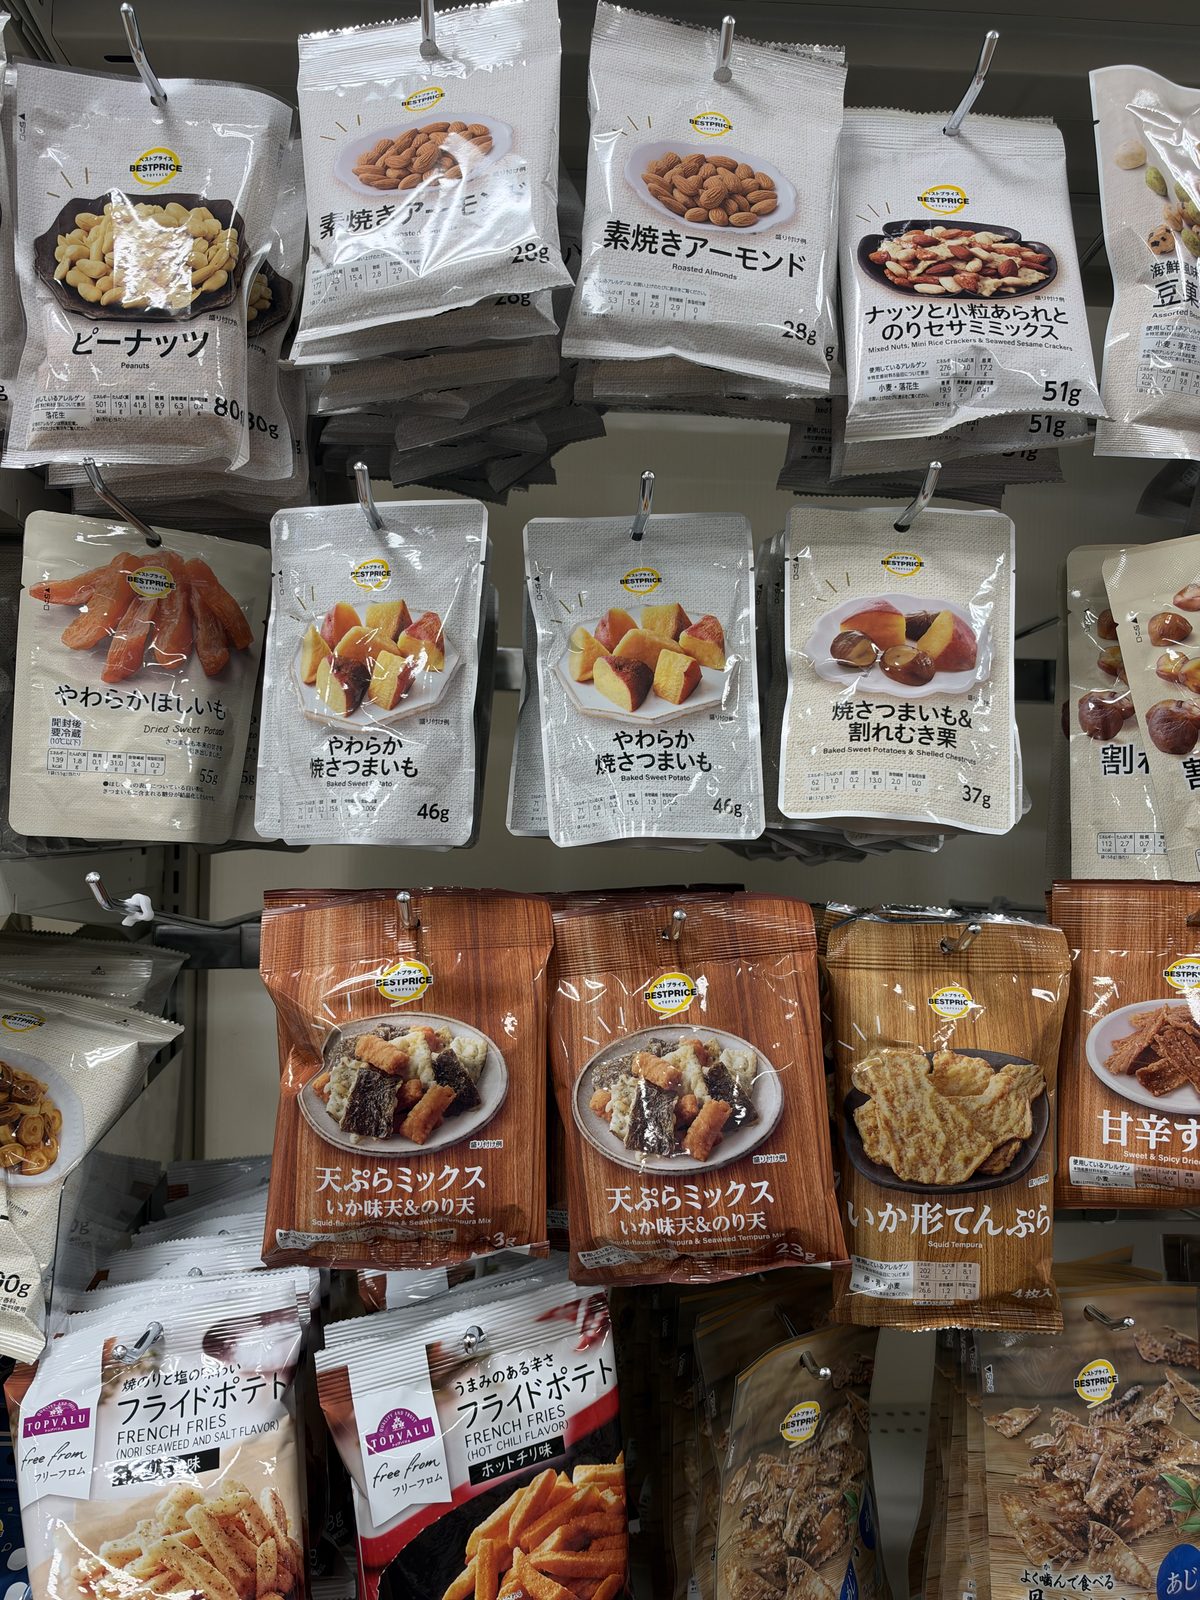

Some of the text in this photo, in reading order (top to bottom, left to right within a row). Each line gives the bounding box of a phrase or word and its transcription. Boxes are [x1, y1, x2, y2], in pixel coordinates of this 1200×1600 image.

[401, 93, 446, 106] BESTPRICE
[689, 118, 734, 131] BESTPRICE
[129, 163, 183, 173] BESTPRICE
[139, 155, 173, 163] ベストプライス
[917, 196, 970, 205] BESTPRICE
[511, 243, 550, 264] 28g
[602, 219, 807, 278] 素焼きアーモンド
[672, 263, 738, 281] Roasted Almonds
[865, 303, 1069, 325] ナッツと小粒あられと
[1152, 309, 1188, 318] Assorted
[782, 320, 817, 346] 28g
[881, 320, 1059, 341] のりセサミミックス
[72, 327, 209, 358] ピーナッツ
[868, 345, 888, 354] Mixed
[890, 342, 909, 352] Nuts,
[911, 340, 927, 348] Mini
[927, 339, 943, 347] Rice
[944, 337, 976, 346] Crackers
[985, 338, 1015, 347] Seaweed
[1016, 340, 1043, 349] Sesame
[1044, 343, 1073, 352] Crackers
[120, 362, 150, 370] Peanuts
[869, 361, 927, 373] 使用しているアレルゲン
[878, 382, 919, 392] 小麦・落花生
[1042, 380, 1082, 407] 51g
[214, 396, 245, 427] 80
[1028, 414, 1066, 437] 51g
[881, 560, 925, 568] BESTPRICE
[127, 576, 176, 589] BESTPRICE
[620, 577, 663, 585] BESTPRICE
[54, 684, 226, 720] やわらかほしいも
[51, 717, 82, 729] 開封後
[419, 718, 450, 726] 盛り付け例
[832, 700, 973, 729] 焼さつまいも&
[50, 728, 82, 738] 要冷蔵
[143, 724, 225, 737] Dried Sweet Potato
[612, 729, 695, 751] やわらか
[848, 722, 957, 748] 割れむき栗
[328, 736, 403, 756] やわらか
[873, 747, 906, 755] Potatoes
[916, 750, 944, 758] Shelled
[945, 753, 977, 765] Chestnuts
[310, 756, 418, 779] 焼さつまいも
[595, 750, 712, 776] 焼さつまいも
[199, 768, 219, 785] 55g
[621, 774, 643, 782] Baked
[668, 774, 691, 782] Potato
[962, 785, 991, 809] 37g
[417, 803, 450, 823] 46g
[375, 976, 433, 988] BESTPRICE
[653, 981, 687, 989] ベストプライス
[644, 988, 697, 1000] BESTPRICE
[469, 1139, 503, 1149] 盛り付け例
[753, 1153, 787, 1164] 盛り付け例
[1073, 1159, 1130, 1171] 使用しているアレルゲン
[1123, 1150, 1148, 1160] Sweet
[1158, 1154, 1181, 1165] Spicy
[315, 1165, 486, 1194] 天ぷらミックス
[605, 1180, 774, 1214] 天ぷらミックス
[326, 1196, 475, 1219] いか味天&のり天
[619, 1211, 767, 1236] いか味天&のり天
[847, 1201, 1051, 1238] いか形てんぷら
[702, 1235, 736, 1244] Seaweed
[738, 1233, 770, 1242] Tempura
[927, 1240, 983, 1250] Squid Tempura
[775, 1243, 816, 1262] 23g
[1011, 1288, 1053, 1299] 4枚入
[455, 1353, 554, 1396] うまみのある辛さ
[1074, 1375, 1118, 1388] BESTPRICE
[117, 1372, 286, 1425] フライドポテト
[457, 1358, 613, 1429] フライドポテト
[27, 1414, 86, 1431] TOPVALU
[117, 1413, 226, 1445] FRENCH FRIES
[379, 1413, 393, 1432] QUALITY
[405, 1411, 417, 1423] TRUST
[464, 1404, 566, 1448] FRENCH FRIES
[116, 1419, 279, 1460] (NORI SEAWEED AND SALT FLAVOR)
[371, 1424, 430, 1448] TOPVALU
[467, 1419, 569, 1462] (HOT CHILI FLAVOR)
[21, 1441, 88, 1471] free from
[482, 1443, 553, 1478] ホットチリ味
[34, 1467, 86, 1483] フリーフロム
[373, 1453, 441, 1488] free from
[392, 1473, 443, 1497] フリーフロム
[1021, 1570, 1114, 1591] よく噛んで食べる
[1167, 1567, 1197, 1595] あじ
